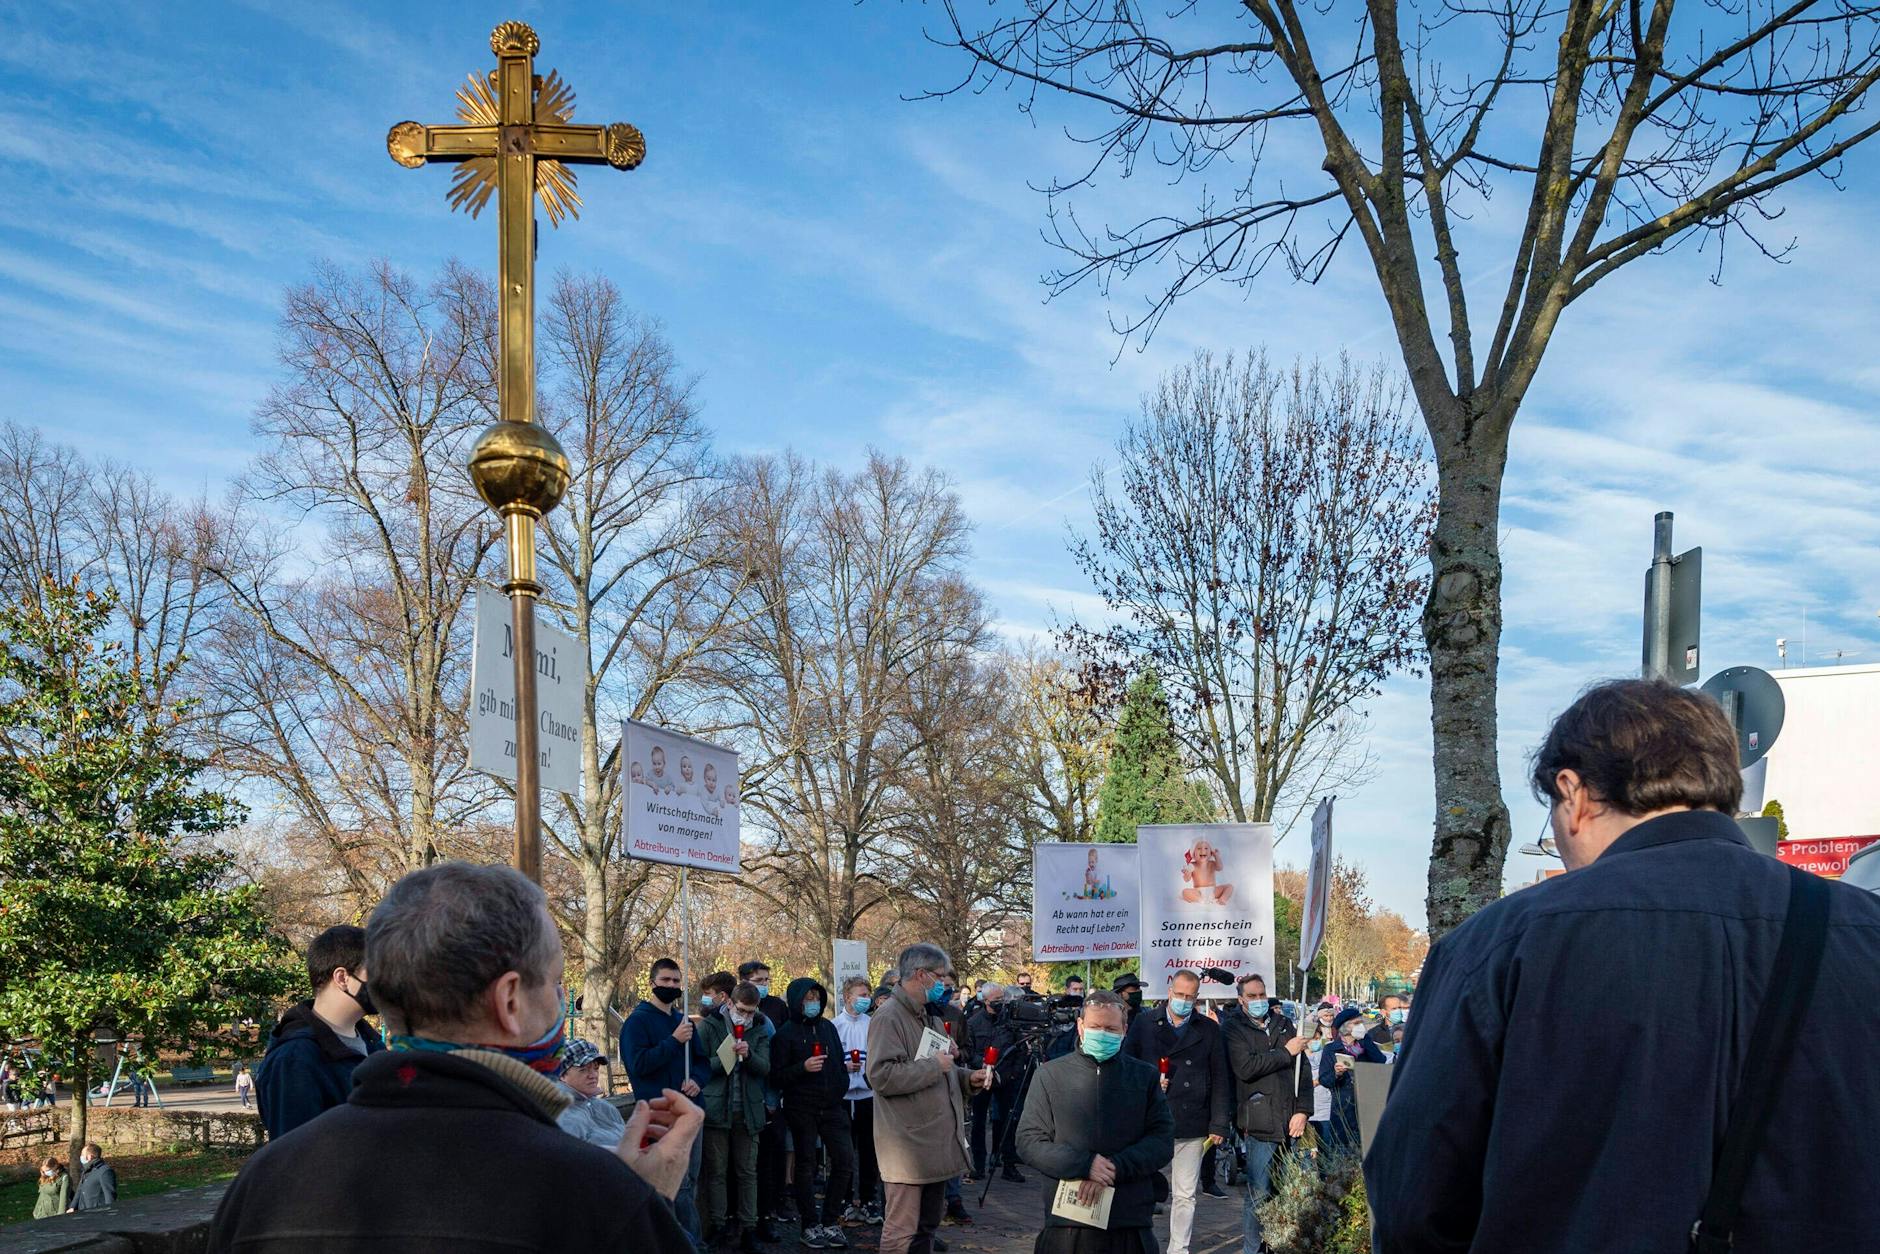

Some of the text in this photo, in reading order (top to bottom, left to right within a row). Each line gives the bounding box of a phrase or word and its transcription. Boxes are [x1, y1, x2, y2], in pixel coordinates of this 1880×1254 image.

[479, 688, 578, 743] gib mi Chance
[646, 801, 723, 826] Wirtschaftsmacht
[658, 823, 713, 840] von morgen!
[634, 839, 680, 857] Abtreibung
[687, 848, 705, 860] Nein
[707, 852, 734, 864] Danke!
[1791, 840, 1860, 855] Problem
[1052, 908, 1129, 919] Ab wann hat er ein
[1056, 922, 1126, 935] Recht auf Leben?
[1161, 919, 1252, 931] Sonnenschein
[1040, 943, 1085, 954] Abtreibung
[1092, 942, 1110, 951] Nein
[1110, 940, 1138, 951] Danke!
[1151, 935, 1264, 948] statt trübe Tage!
[1164, 957, 1241, 968] Abtreibung
